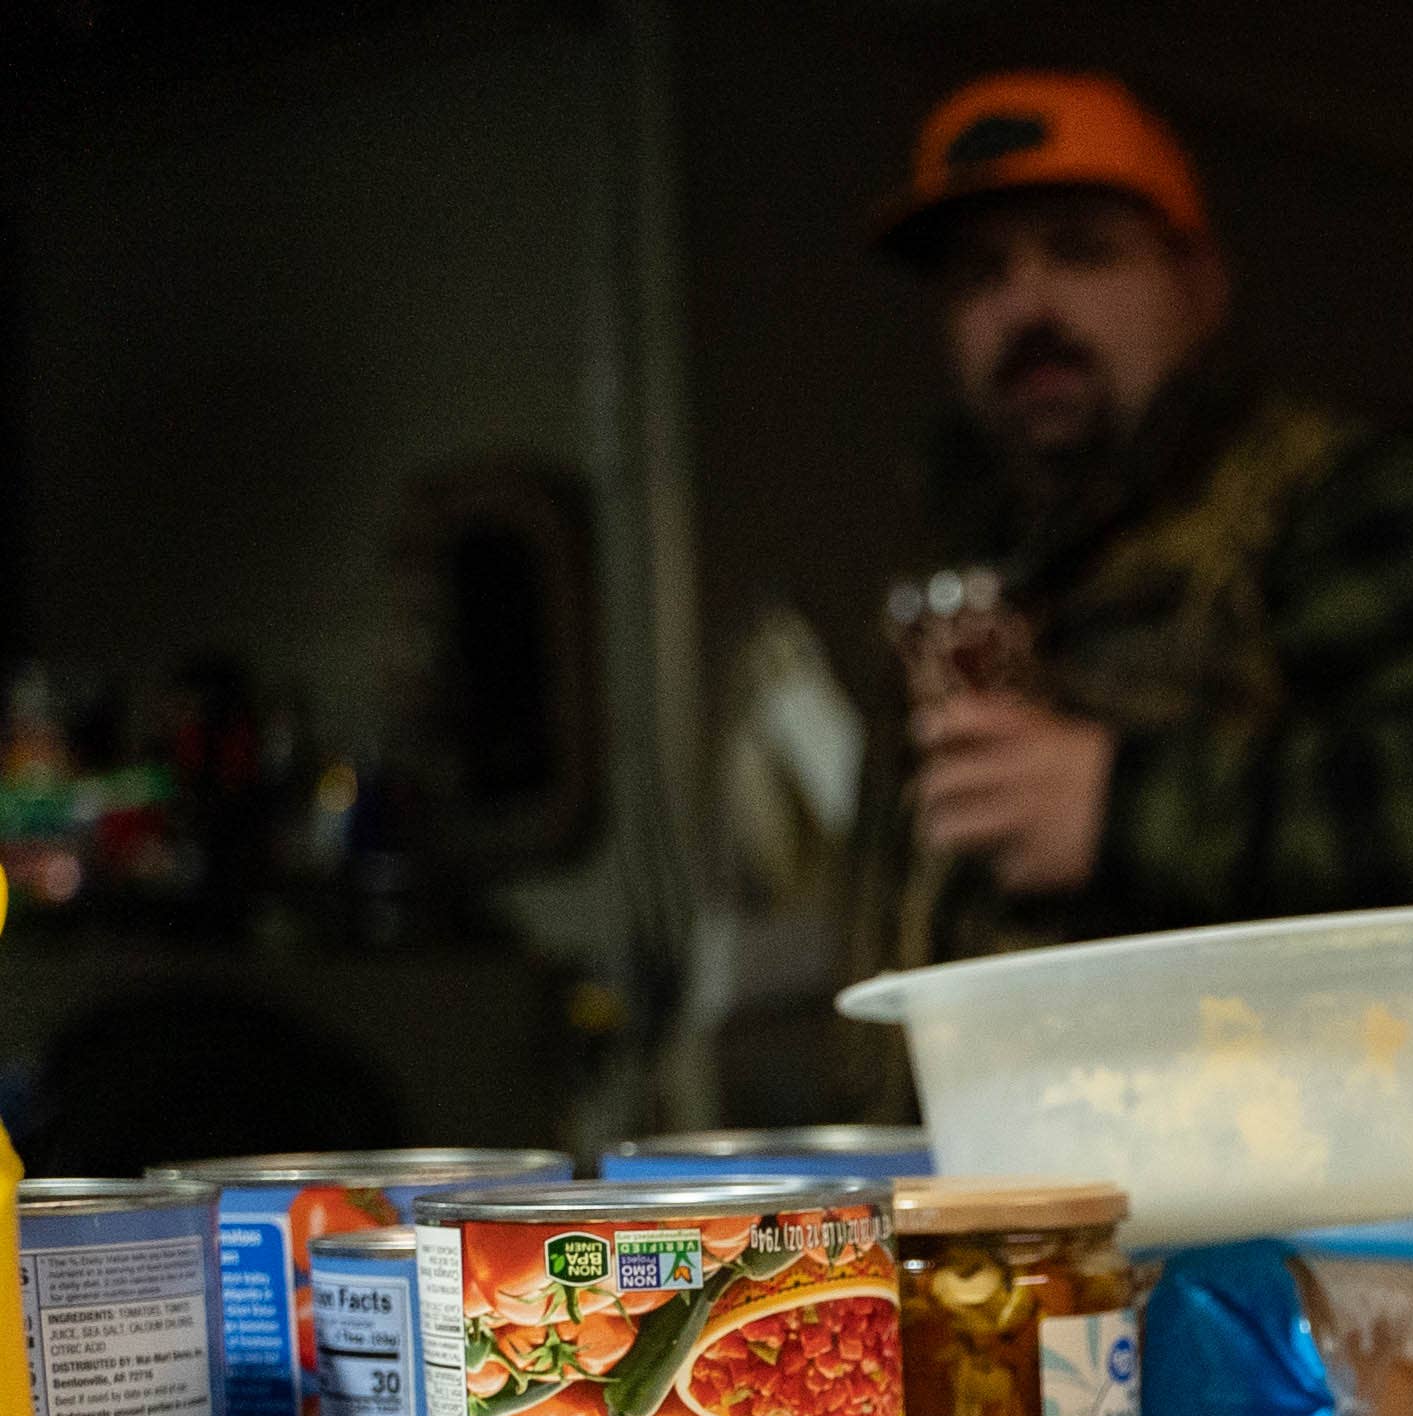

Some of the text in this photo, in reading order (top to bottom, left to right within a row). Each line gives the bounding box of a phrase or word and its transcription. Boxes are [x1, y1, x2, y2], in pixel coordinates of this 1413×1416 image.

[750, 1223, 781, 1254] 794g
[565, 1242, 603, 1253] LINER
[620, 1241, 696, 1253] VERIFIED
[566, 1253, 603, 1266] BPA
[568, 1265, 602, 1277] NON
[621, 1265, 658, 1276] GMO
[622, 1276, 658, 1288] NON
[339, 1285, 393, 1314] Facts
[52, 1357, 118, 1374] DISTRIBUTED
[372, 1369, 400, 1394] 30
